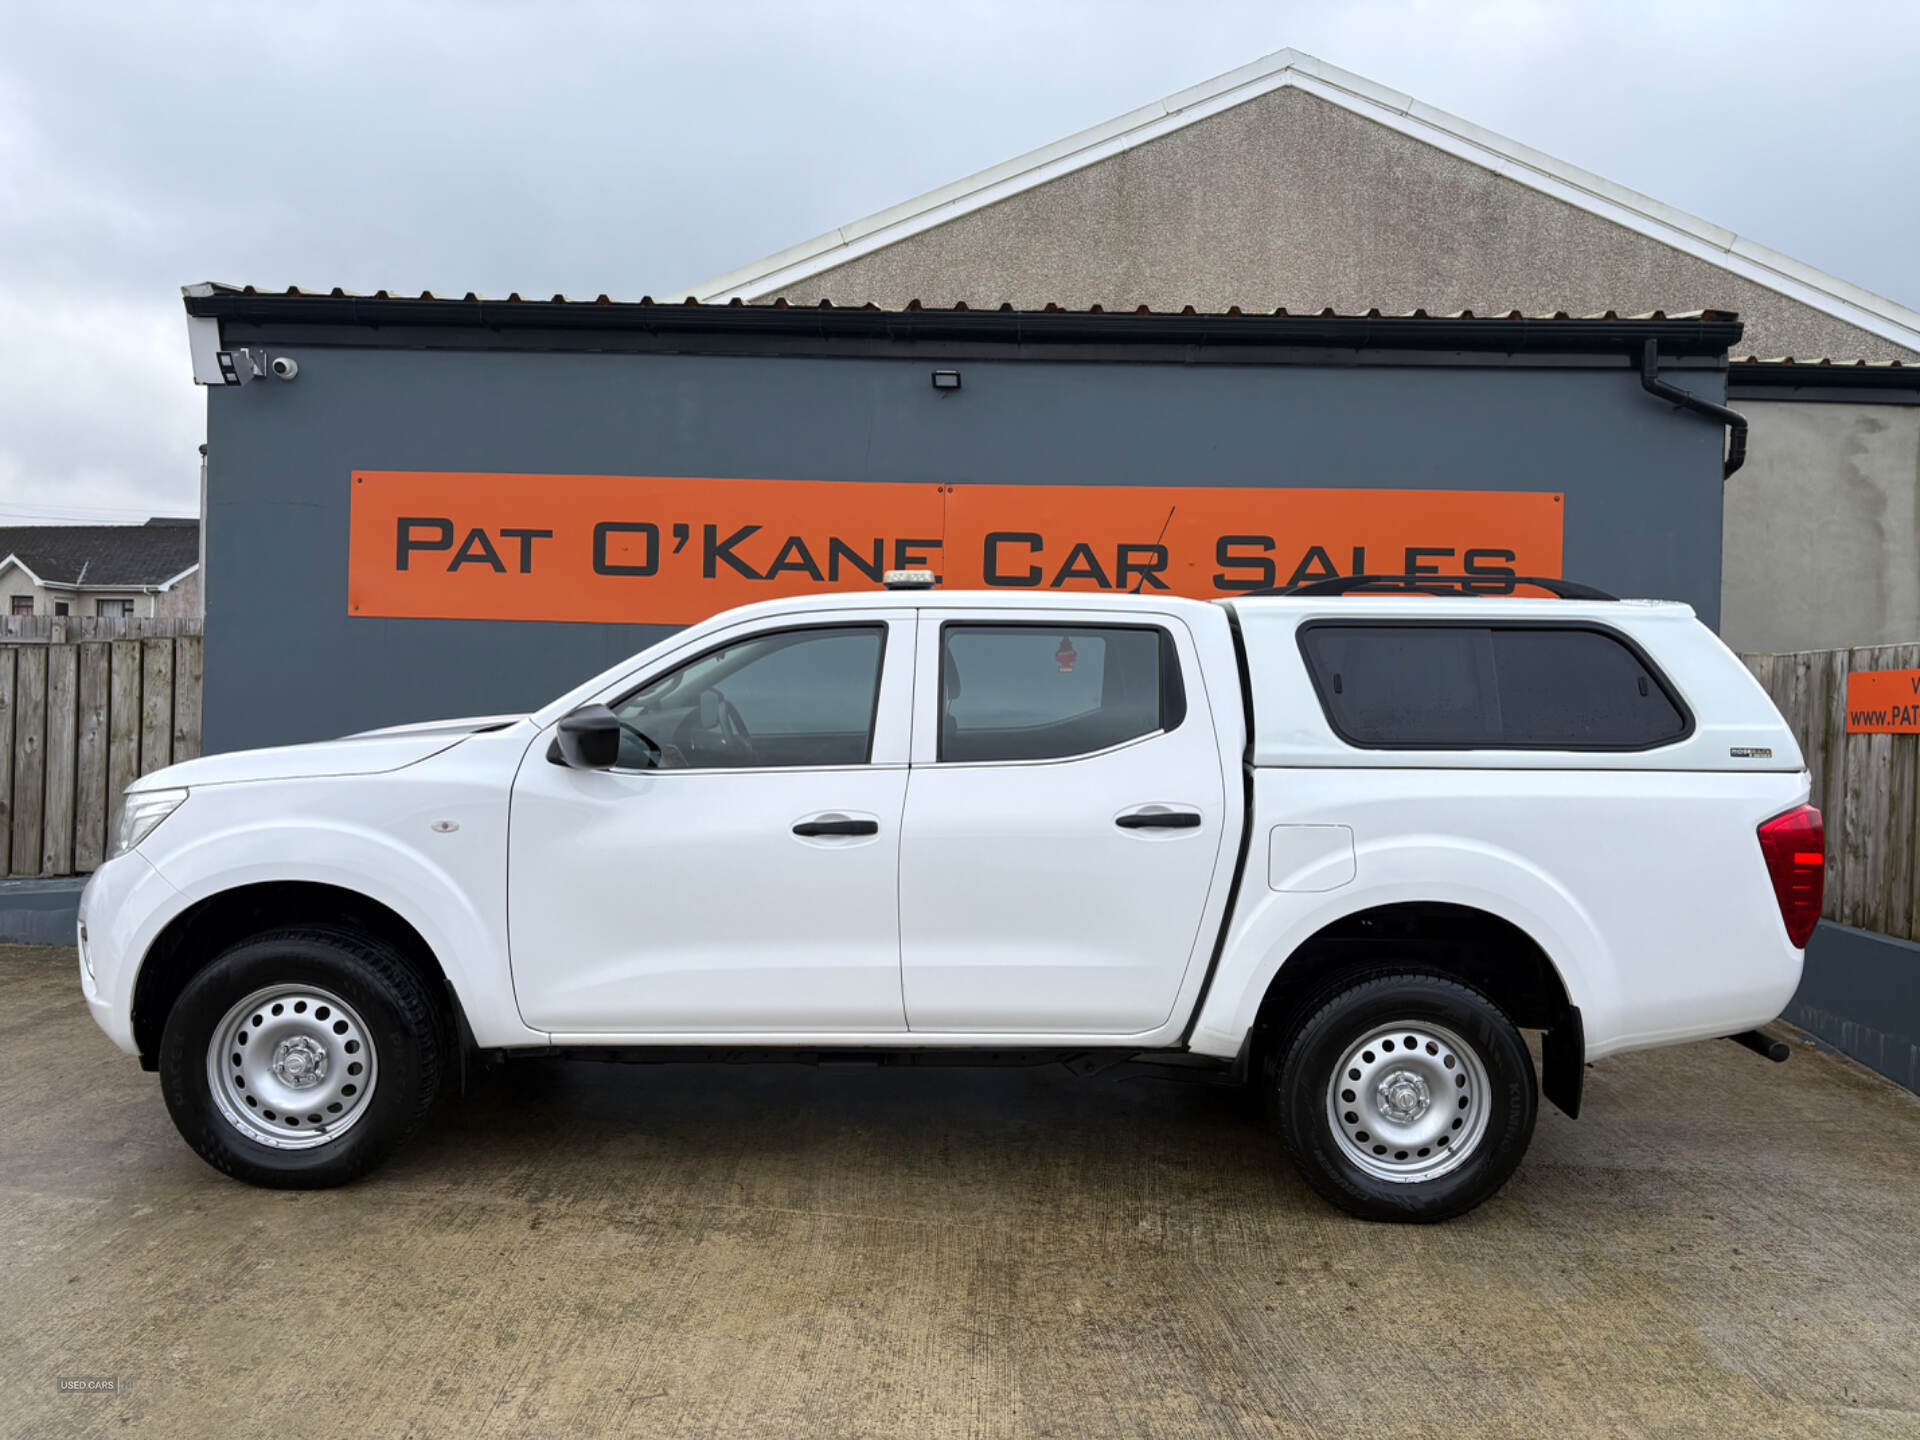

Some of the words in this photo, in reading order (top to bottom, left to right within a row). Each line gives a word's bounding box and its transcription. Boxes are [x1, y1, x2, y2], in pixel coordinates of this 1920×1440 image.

[395, 516, 554, 575] PAT
[592, 520, 944, 584] O'KANE
[983, 531, 1170, 589] CAR
[1212, 535, 1517, 595] SALES
